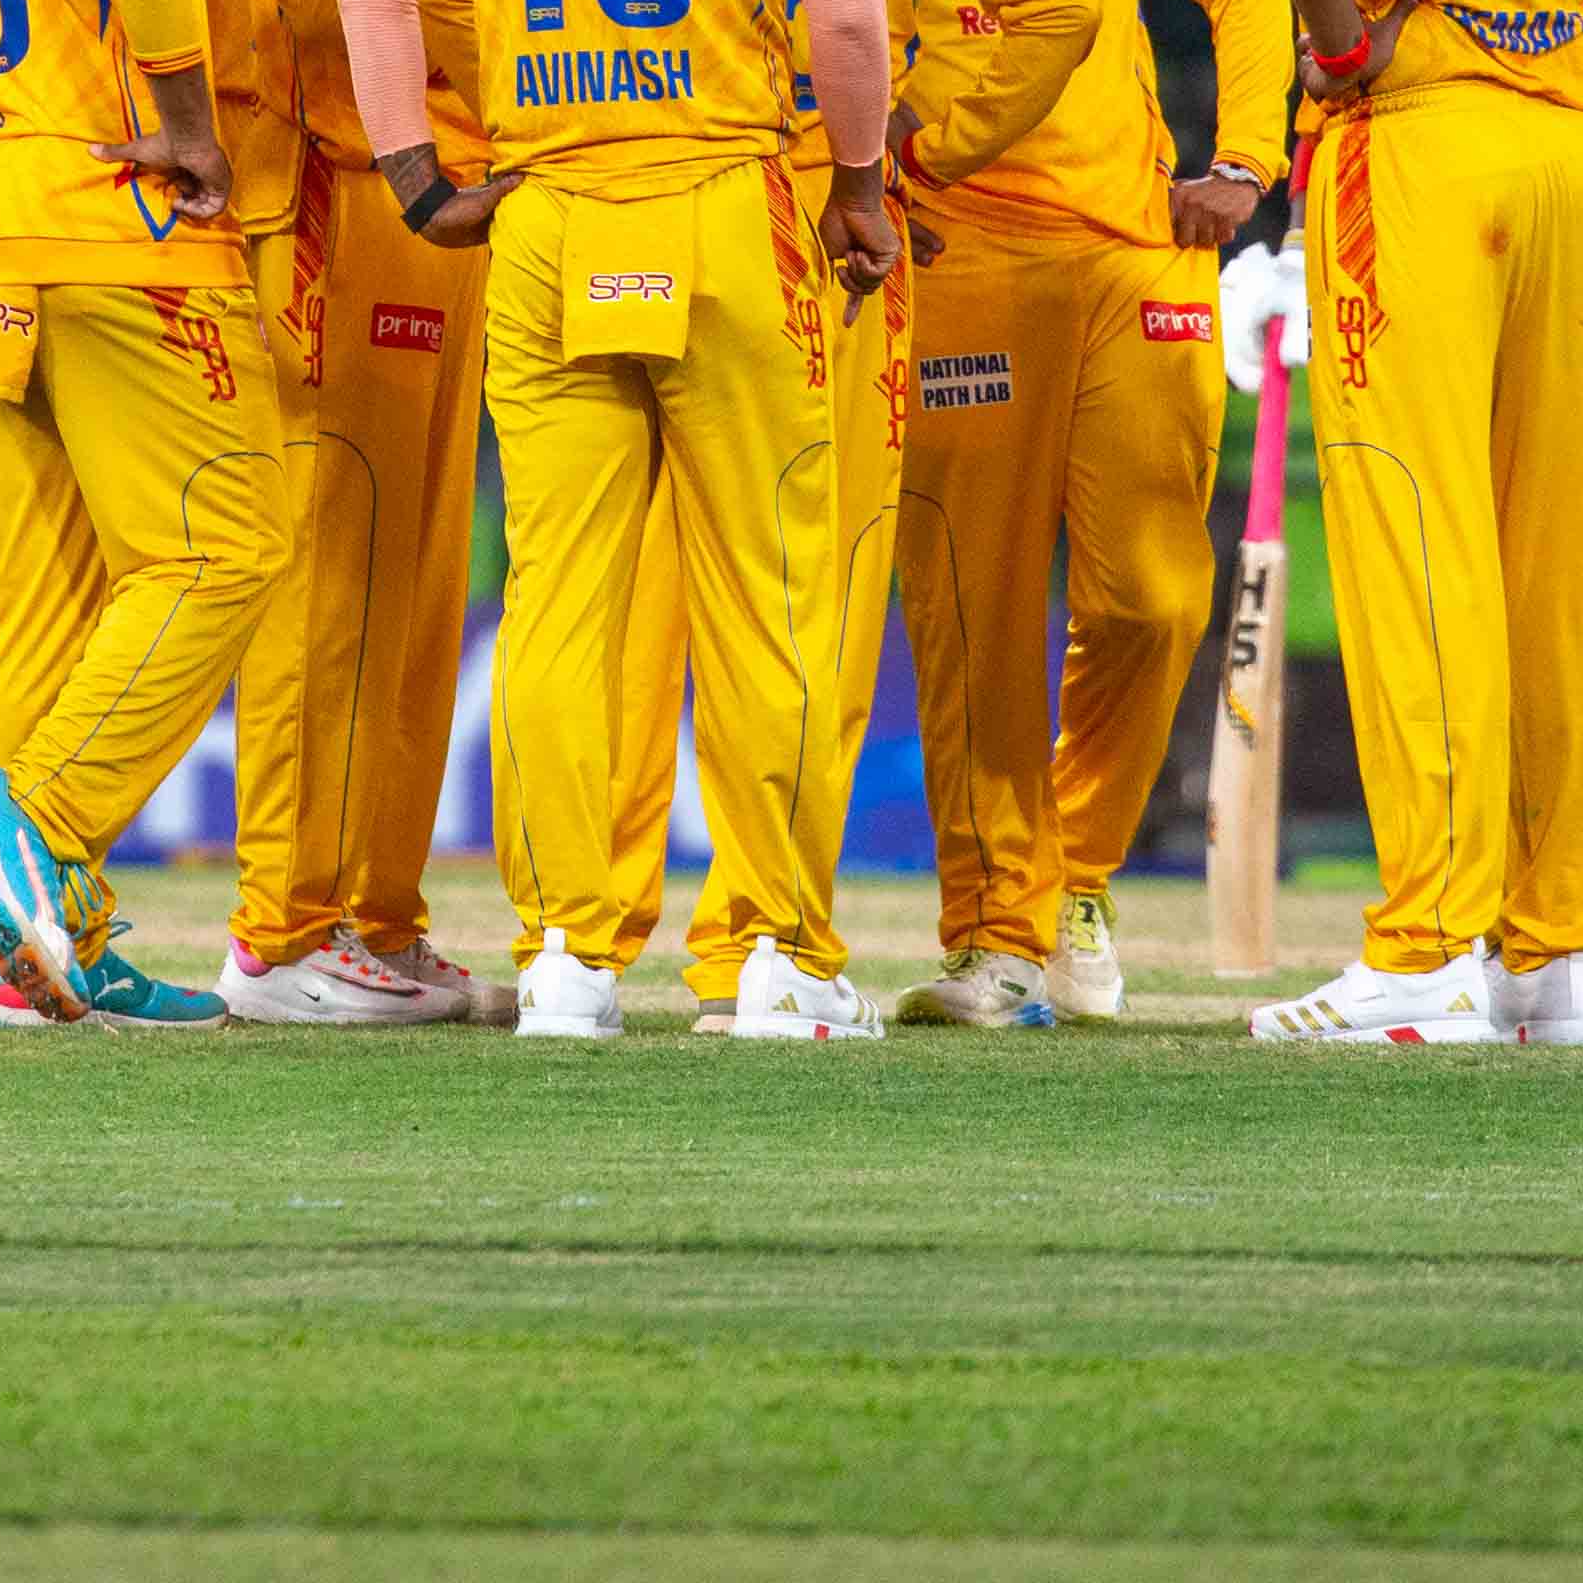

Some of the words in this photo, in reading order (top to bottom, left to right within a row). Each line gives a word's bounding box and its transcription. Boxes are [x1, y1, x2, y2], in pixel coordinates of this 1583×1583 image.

[516, 48, 694, 107] AVINASH
[589, 272, 673, 302] SPR
[377, 313, 443, 342] prime
[1146, 309, 1211, 334] prime
[919, 353, 1010, 381] NATIONAL
[923, 386, 970, 409] PATH
[974, 383, 1010, 404] LAB
